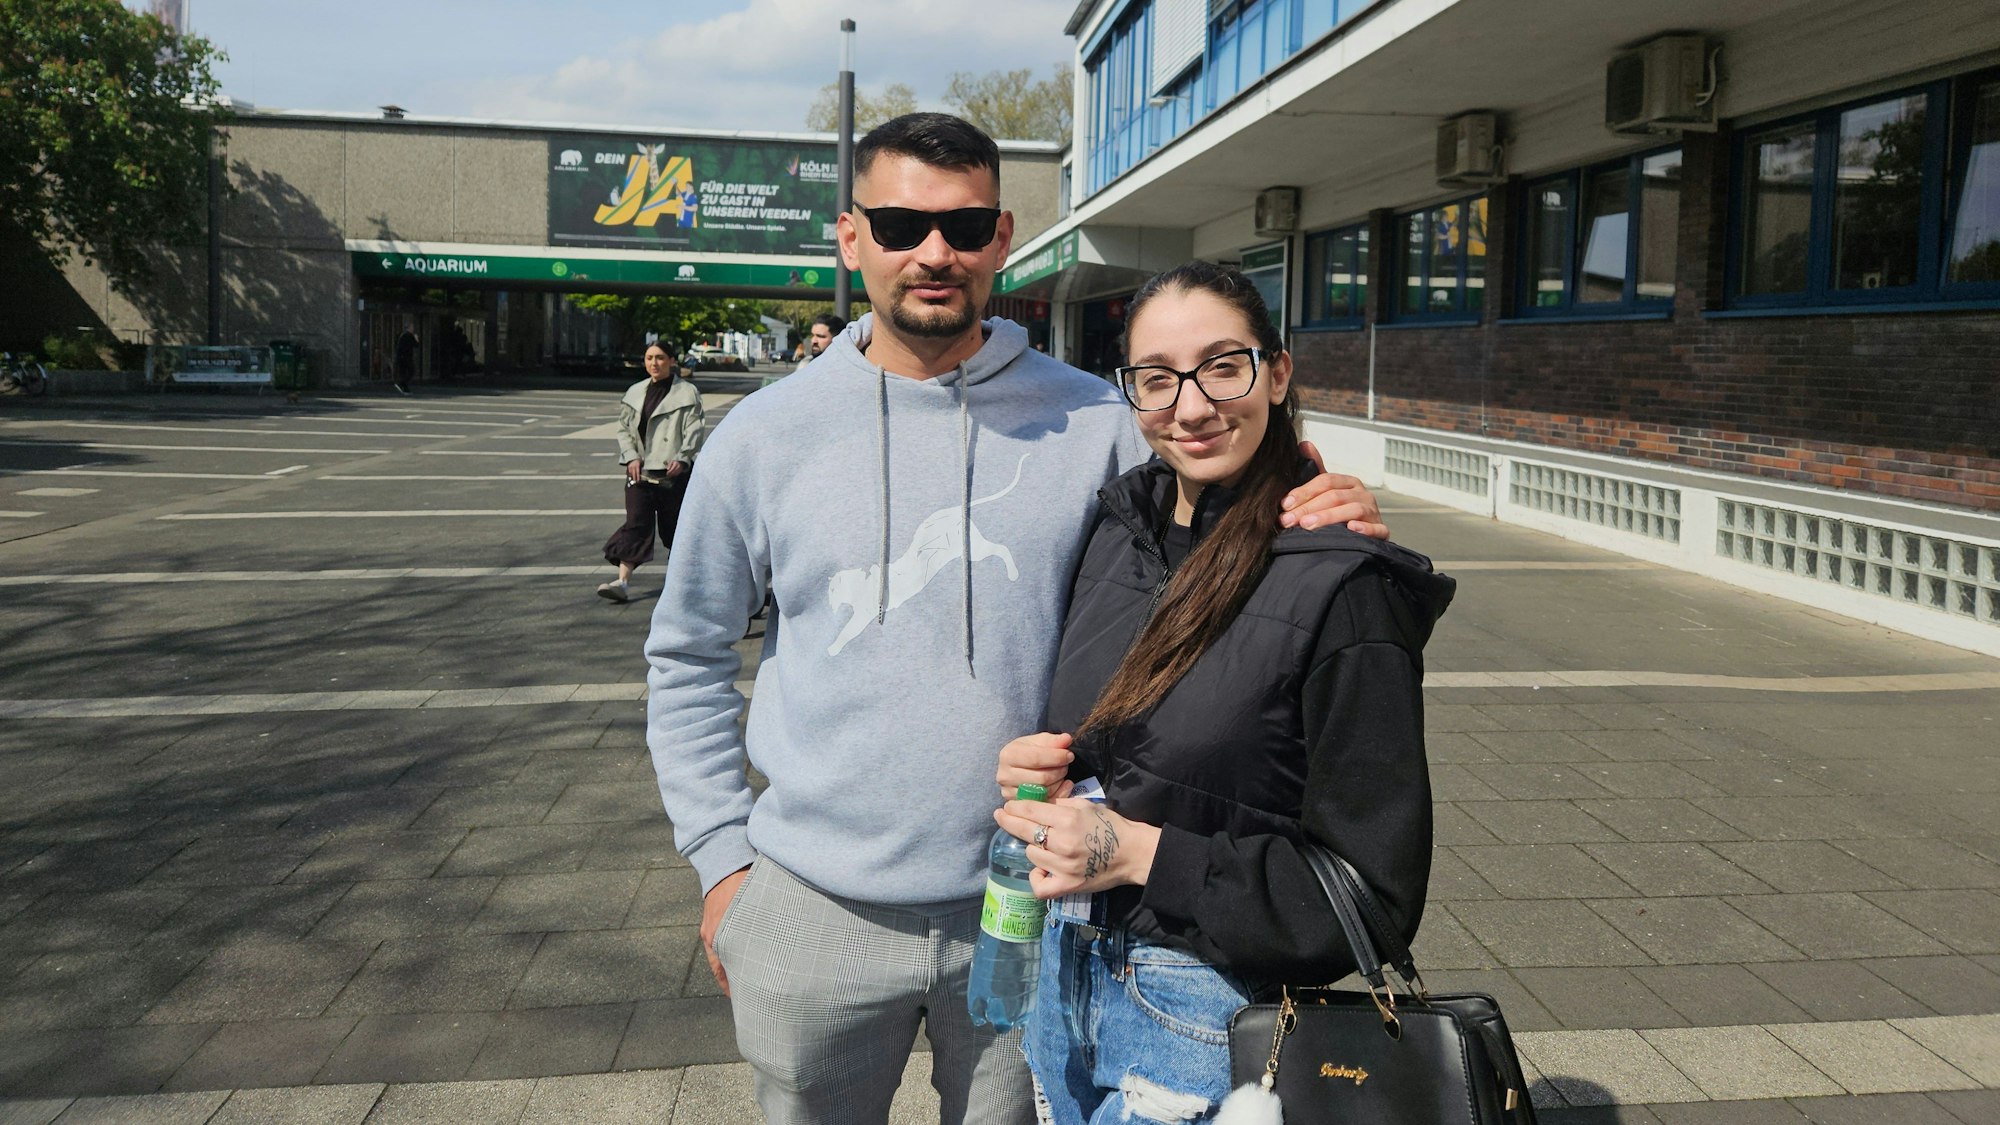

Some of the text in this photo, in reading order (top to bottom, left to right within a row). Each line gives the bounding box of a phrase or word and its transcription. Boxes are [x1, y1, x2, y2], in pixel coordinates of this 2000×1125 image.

[595, 153, 625, 164] DEIN
[800, 160, 831, 172] KÖLN
[594, 154, 697, 228] JA
[699, 181, 780, 196] FÜR DIE WELT
[701, 194, 766, 207] ZU GAST IN
[702, 206, 811, 221] UNSEREN VEEDELN
[404, 257, 488, 273] AQUARIUM
[1096, 813, 1120, 872] Amor
